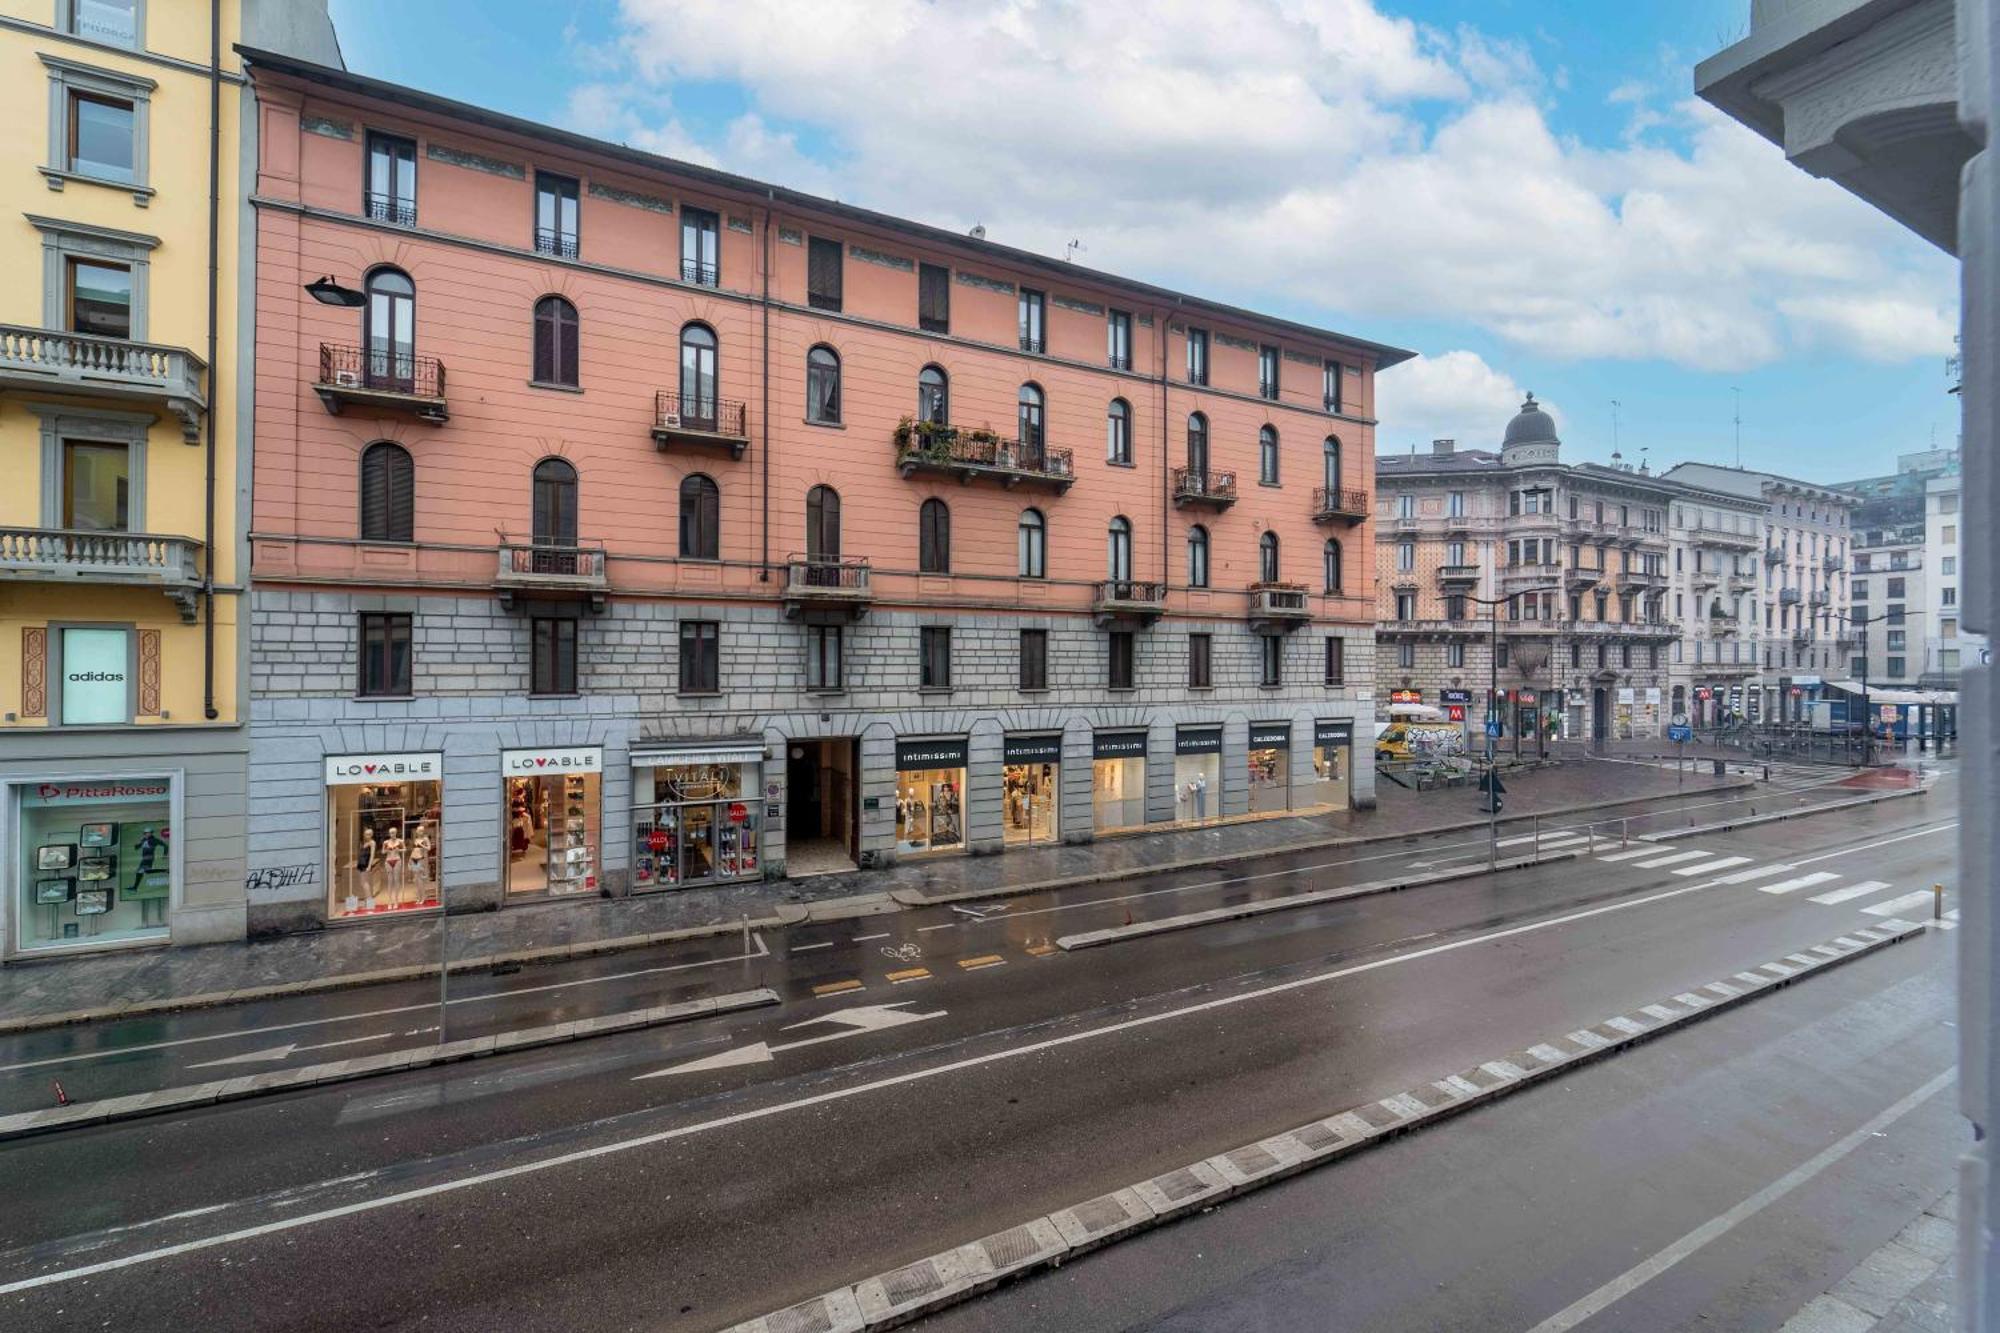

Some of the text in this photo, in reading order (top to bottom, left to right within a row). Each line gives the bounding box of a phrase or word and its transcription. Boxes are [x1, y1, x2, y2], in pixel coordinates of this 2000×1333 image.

[68, 671, 124, 682] adidas
[903, 752, 961, 762] intimissimi
[1007, 747, 1058, 756] intimissimi
[512, 755, 594, 769] LOVABLE
[336, 762, 432, 776] LOVABLE
[674, 771, 724, 783] VITALI
[66, 786, 166, 798] PittaRosso
